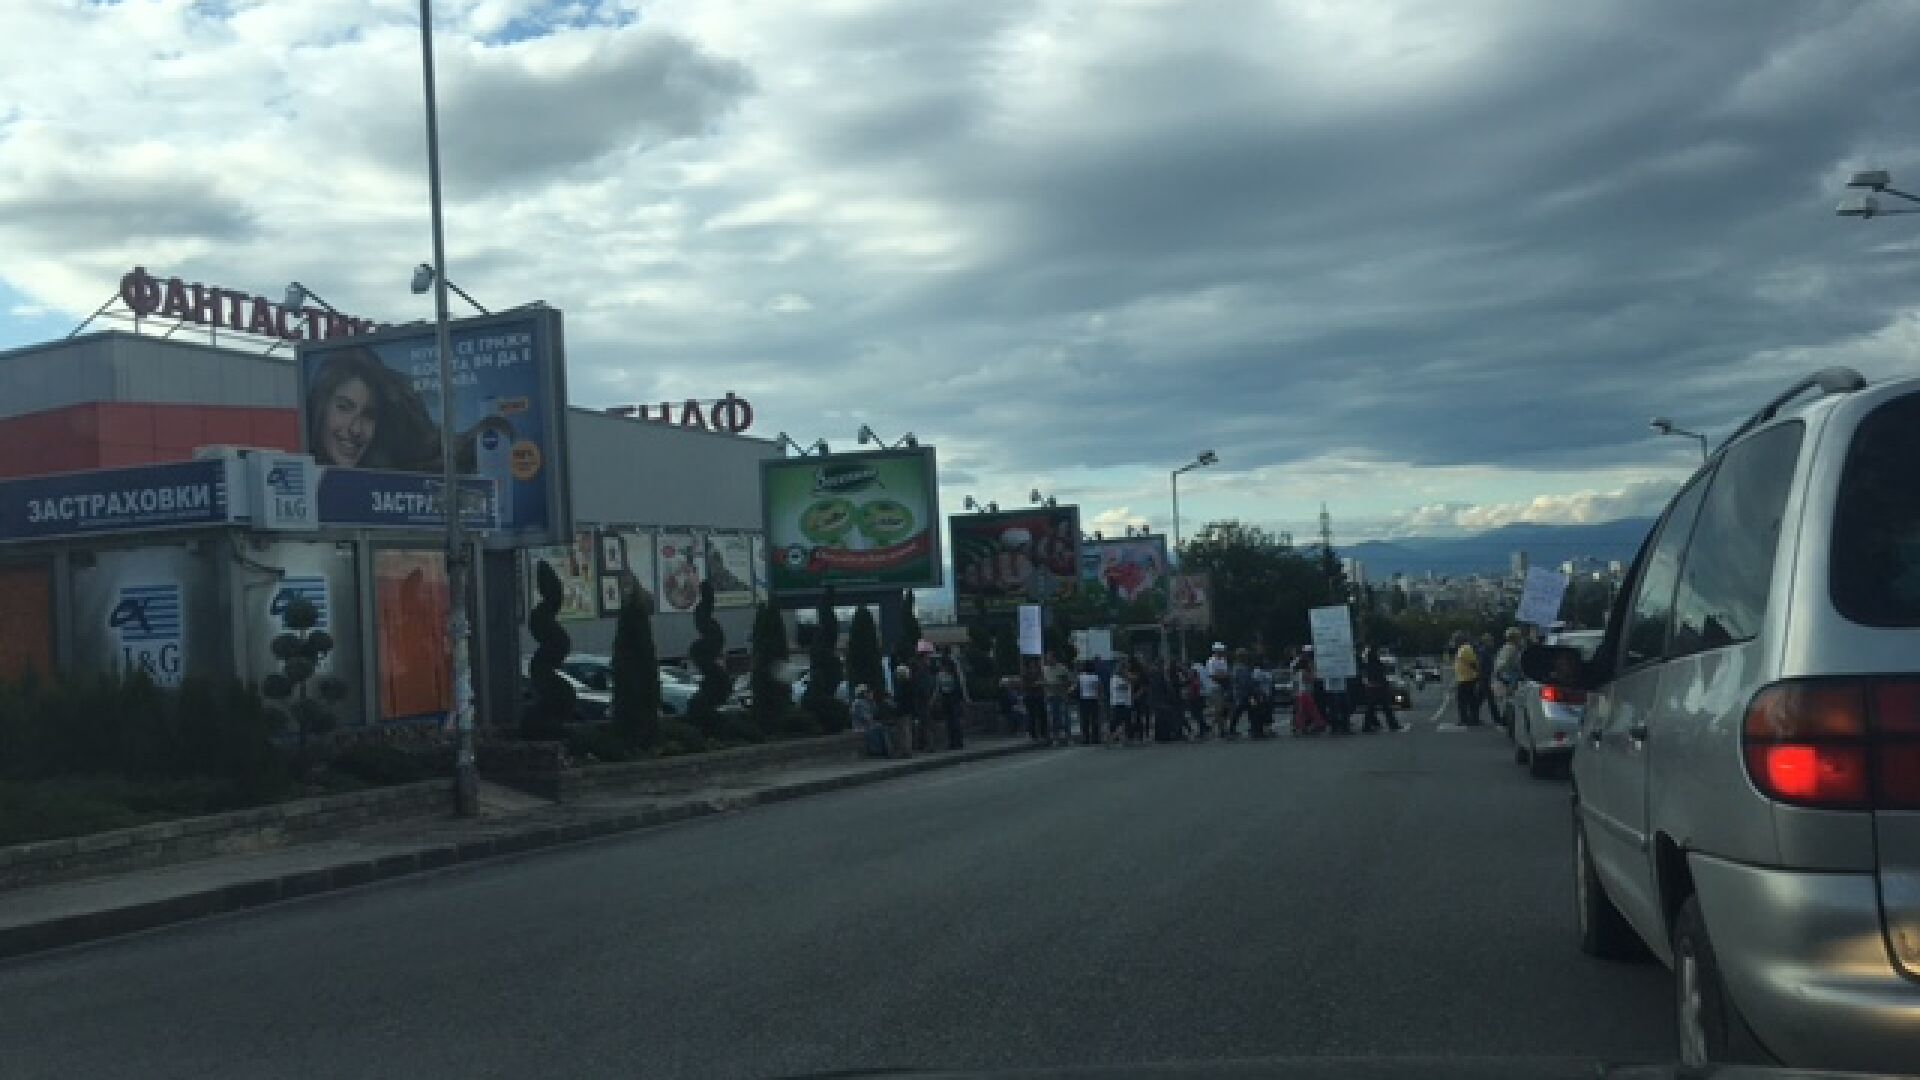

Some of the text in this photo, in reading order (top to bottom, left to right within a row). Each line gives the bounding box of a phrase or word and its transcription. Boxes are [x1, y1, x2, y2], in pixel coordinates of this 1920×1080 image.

[120, 267, 379, 340] ФАНТАСТИК
[456, 340, 474, 355] СЕ
[479, 333, 531, 352] ГРИЖИ
[411, 358, 470, 375] КОСТА
[497, 350, 519, 369] ДА
[413, 373, 477, 391] КРАИВА
[27, 484, 210, 522] ЗАСТРАХОВКИ
